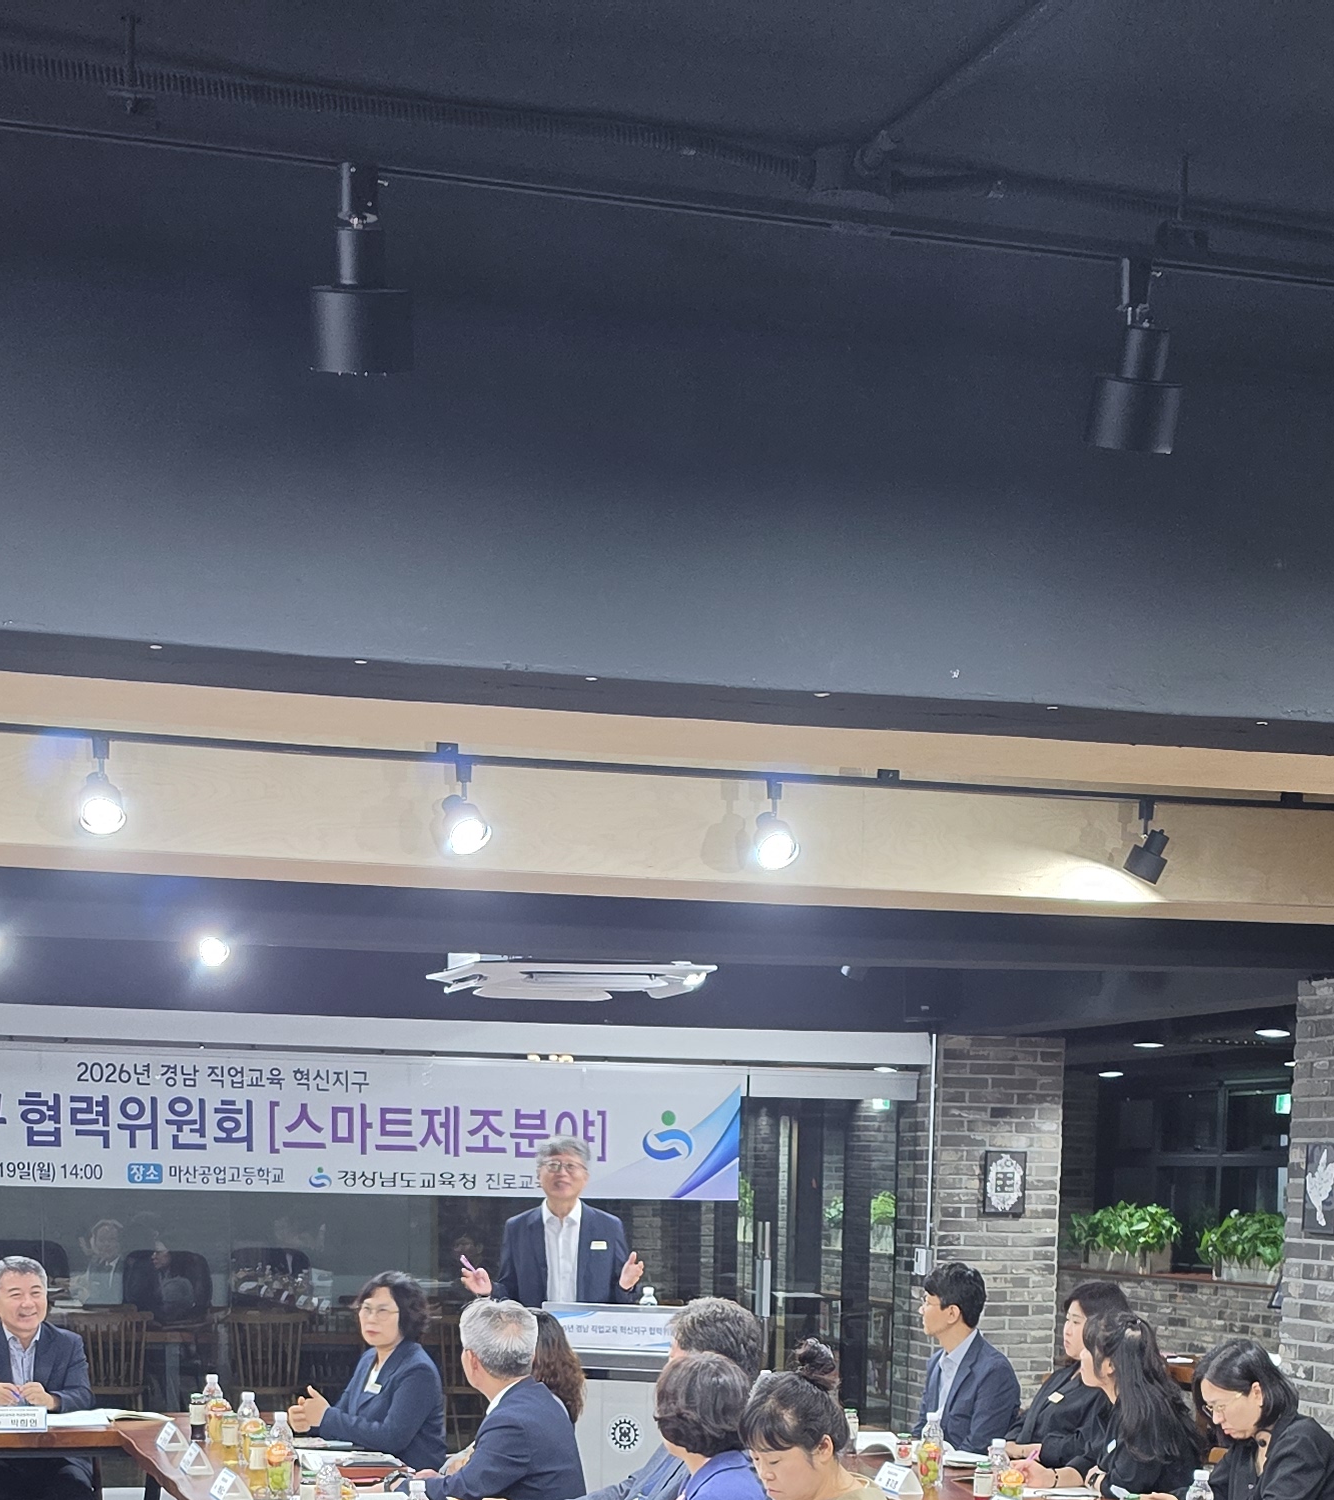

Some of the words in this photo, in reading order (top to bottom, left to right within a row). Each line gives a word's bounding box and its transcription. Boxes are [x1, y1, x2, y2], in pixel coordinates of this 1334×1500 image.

[76, 1062, 152, 1085] 2026년
[160, 1063, 199, 1088] 경남
[207, 1065, 285, 1091] 직업교육
[293, 1069, 370, 1093] 혁신지구
[18, 1091, 255, 1152] 협력위원회
[268, 1100, 607, 1162] [스마트제조분야]
[61, 1164, 103, 1181] 14:00
[129, 1164, 161, 1183] 장소
[169, 1165, 285, 1185] 마산공업고등학교
[338, 1169, 477, 1191] 경상남도교육청
